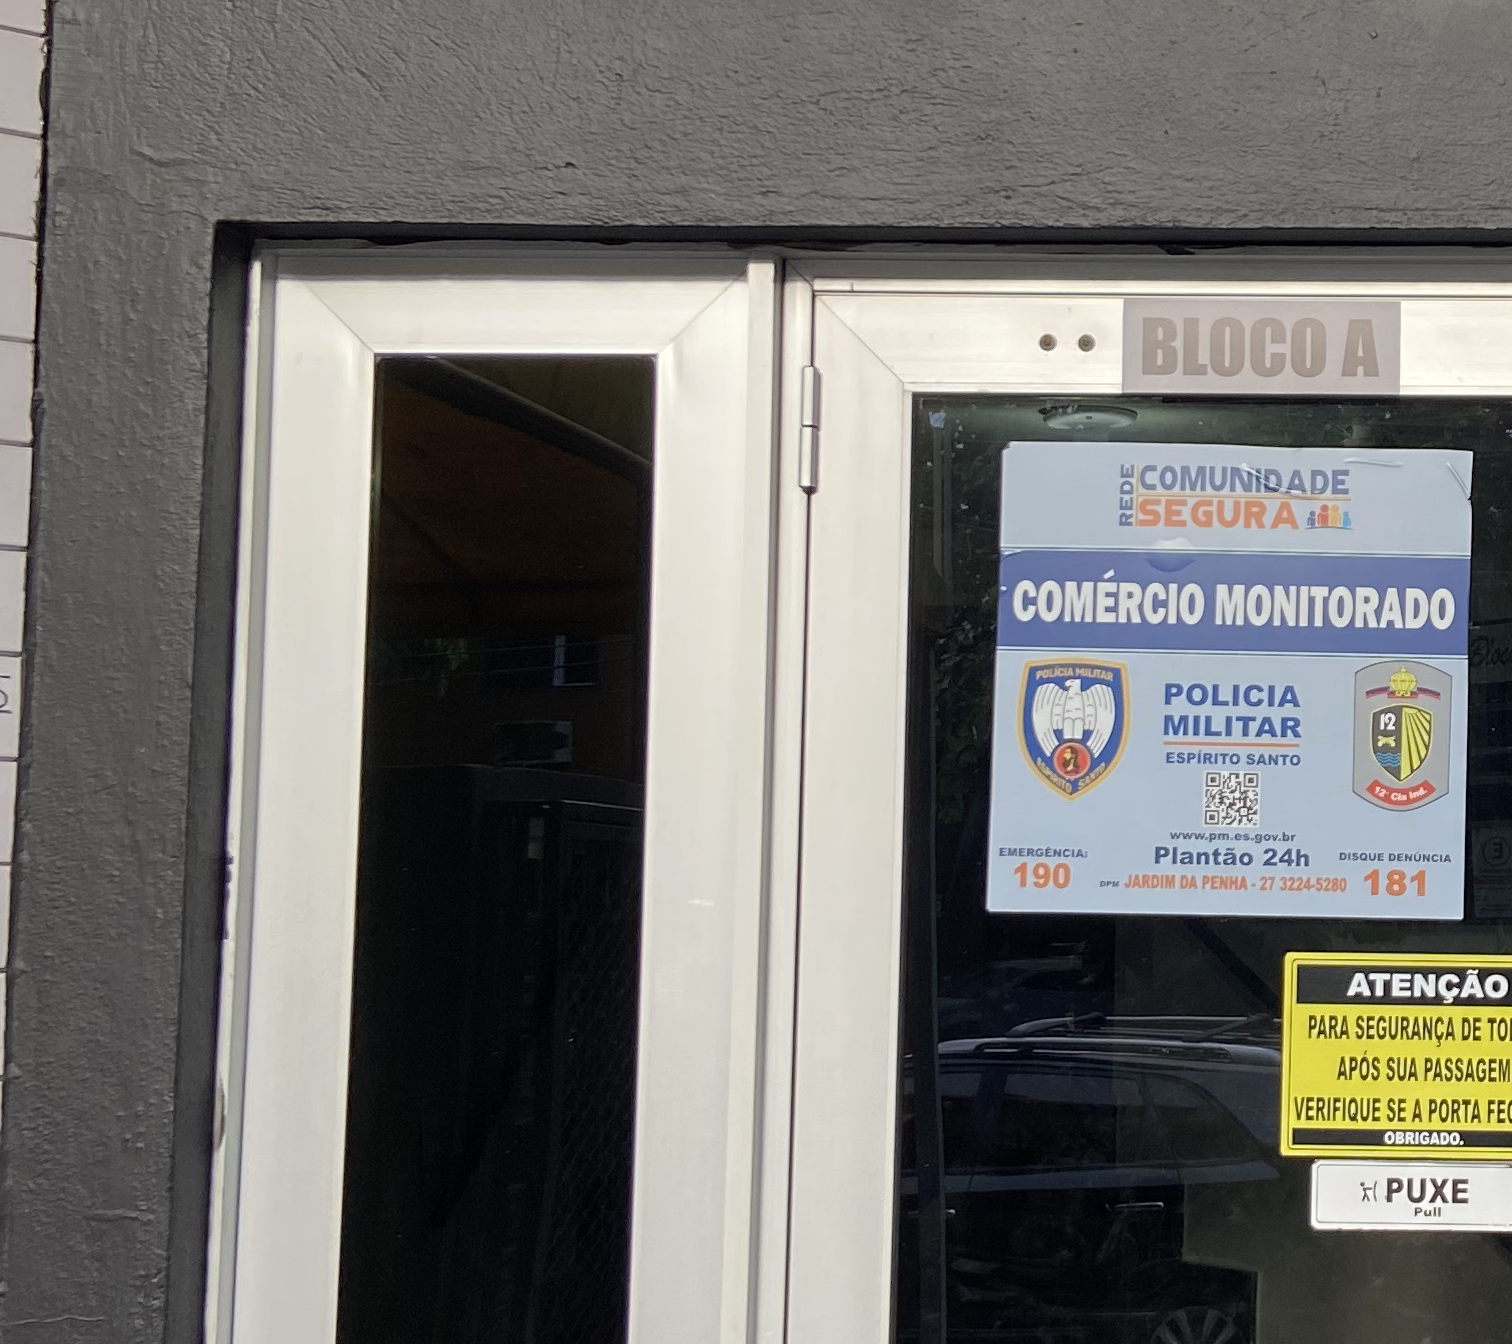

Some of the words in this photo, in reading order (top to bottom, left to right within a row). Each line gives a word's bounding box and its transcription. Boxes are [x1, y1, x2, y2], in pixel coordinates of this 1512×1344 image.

[1141, 316, 1327, 378] BLOCO
[1341, 318, 1380, 377] A
[1140, 464, 1350, 496] COMUNIDADE
[1119, 463, 1134, 527] REDE
[1138, 498, 1299, 530] SEGURA
[1012, 568, 1205, 626] COMÉRCIO
[1215, 583, 1456, 630] MONITORADO
[1036, 665, 1073, 681] POLÍCIA
[1076, 667, 1113, 682] MILITAR
[1163, 683, 1301, 709] POLICIA
[1163, 713, 1302, 739] MILITAR
[1380, 712, 1396, 730] 12
[1165, 750, 1241, 766] ESPÍRITO
[1245, 752, 1302, 767] SANTO
[1170, 830, 1296, 845] www.pm.es.gov.br
[1154, 846, 1255, 867] Plantão
[1262, 848, 1310, 867] 24h
[1339, 852, 1385, 864] DISQUE
[1388, 851, 1452, 864] DENÚNCIA
[1013, 862, 1072, 889] 190
[1100, 879, 1120, 888] DPM
[1124, 874, 1176, 891] JARDIM
[1179, 874, 1199, 891] DA
[1201, 874, 1248, 892] PENHA
[1259, 875, 1276, 892] 27
[1279, 875, 1348, 893] 3224-5280
[1364, 869, 1428, 897] 181
[1347, 969, 1509, 1004] ATENÇÃO
[1308, 1014, 1350, 1040] PARA
[1355, 1015, 1457, 1047] SEGURANÇA
[1461, 1016, 1482, 1041] DE
[1336, 1050, 1381, 1081] APÓS
[1386, 1056, 1419, 1082] SUA
[1294, 1096, 1381, 1123] VERIFIQUE
[1386, 1098, 1407, 1122] SE
[1412, 1098, 1423, 1123] A
[1428, 1098, 1481, 1123] PORTA
[1384, 1131, 1465, 1146] OBRIGADO.
[1386, 1177, 1470, 1204] PUXE
[1414, 1207, 1442, 1218] Pull
